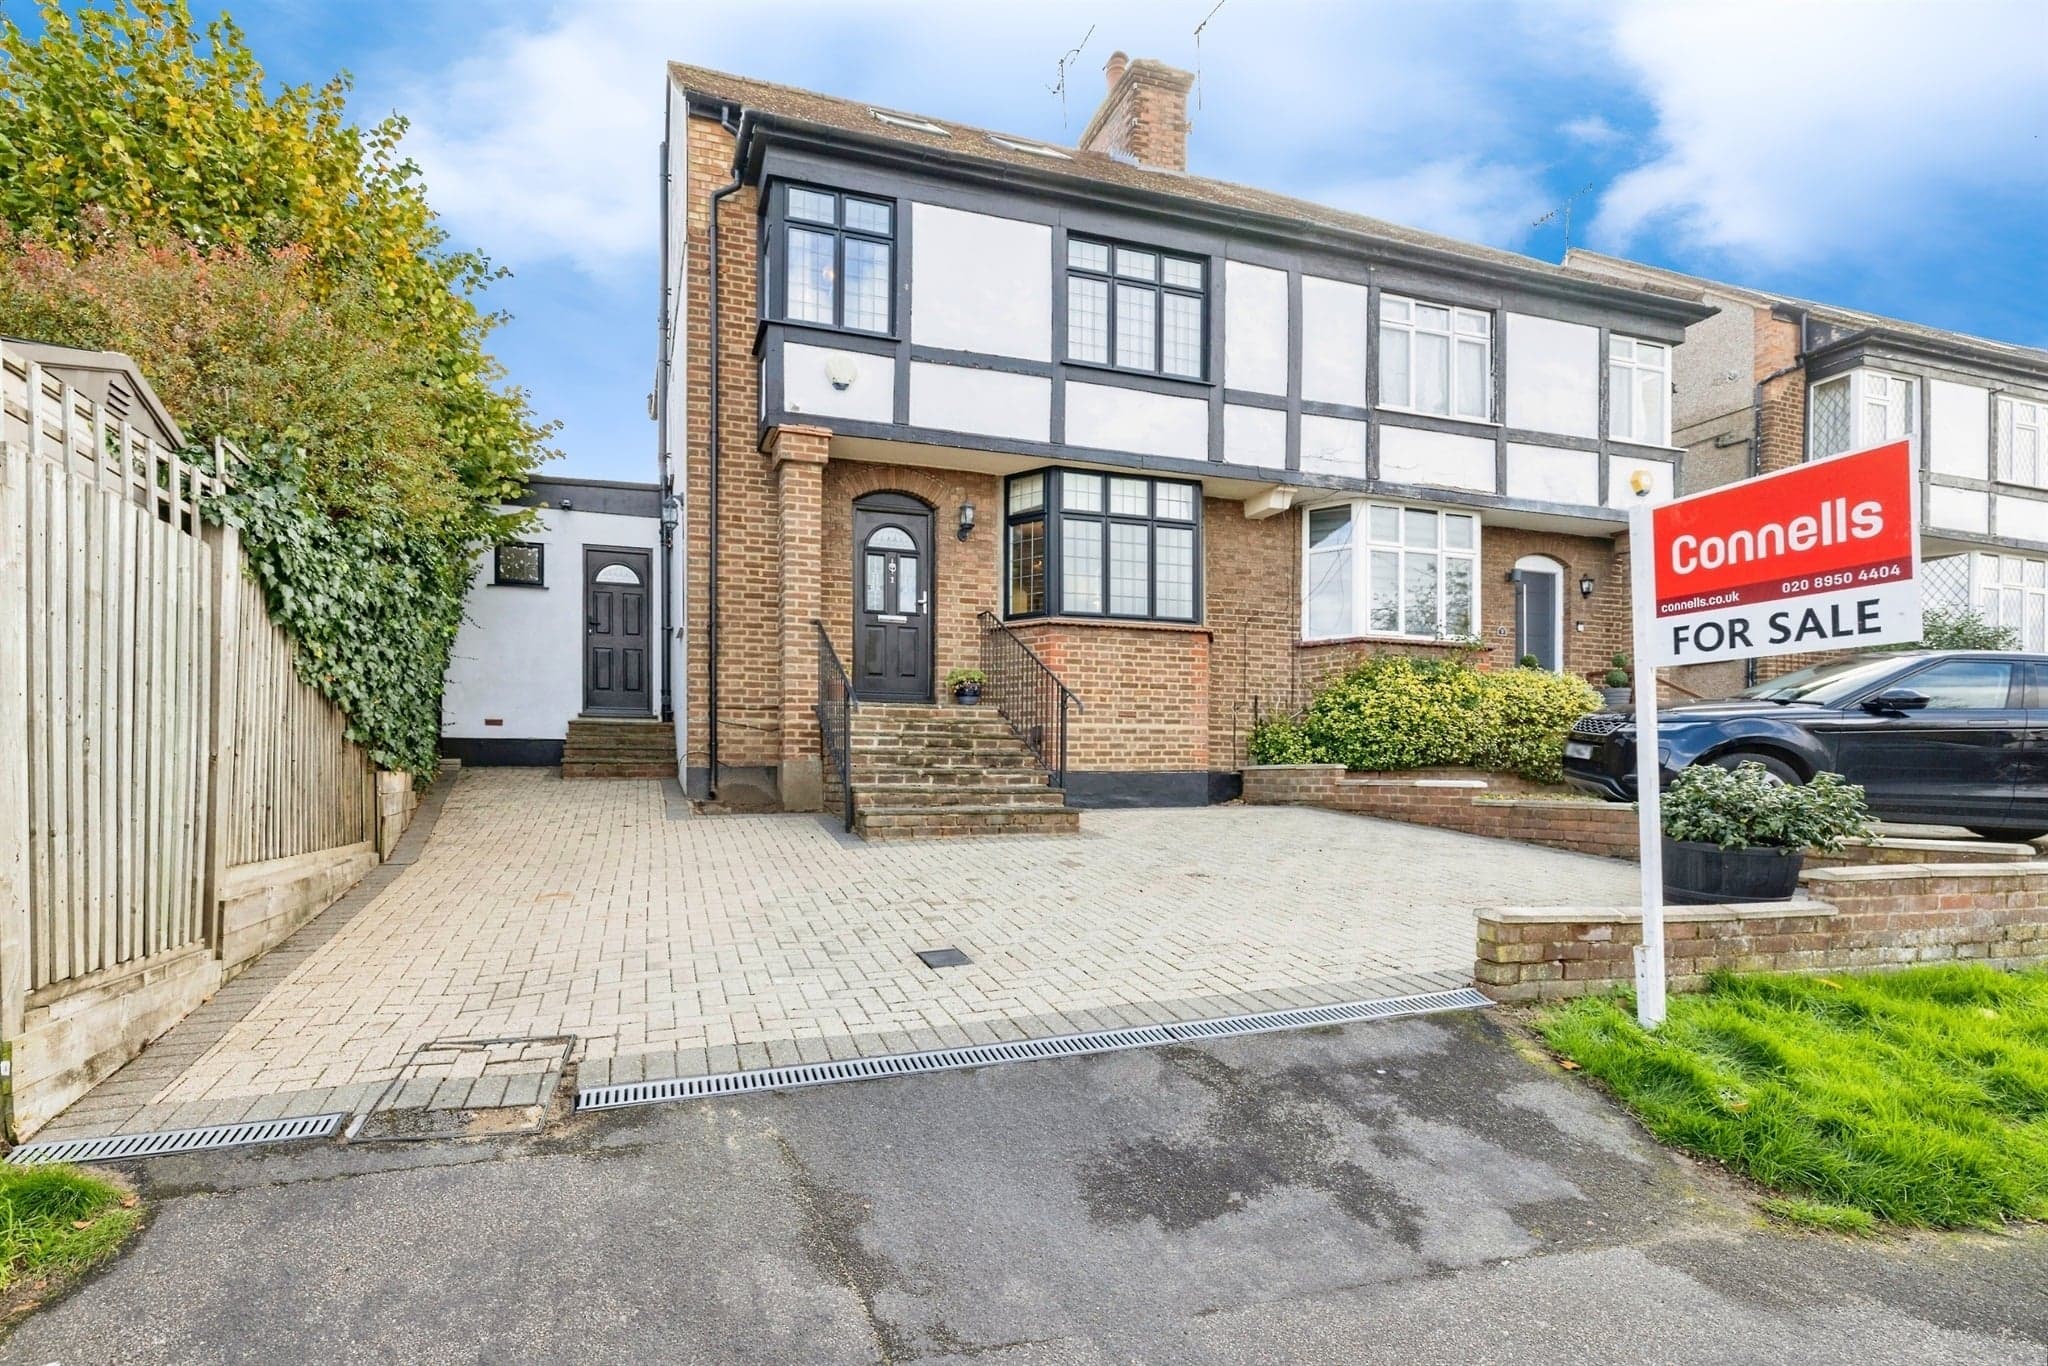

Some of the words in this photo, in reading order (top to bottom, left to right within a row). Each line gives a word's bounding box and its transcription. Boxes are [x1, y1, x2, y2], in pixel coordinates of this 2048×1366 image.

[1671, 497, 1884, 575] Connells
[1782, 579, 1809, 594] 020
[1814, 572, 1852, 589] 8950
[1858, 564, 1900, 582] 4404
[1661, 591, 1740, 613] connells.co.uk
[1673, 618, 1753, 655] FOR
[1768, 598, 1882, 644] SALE
